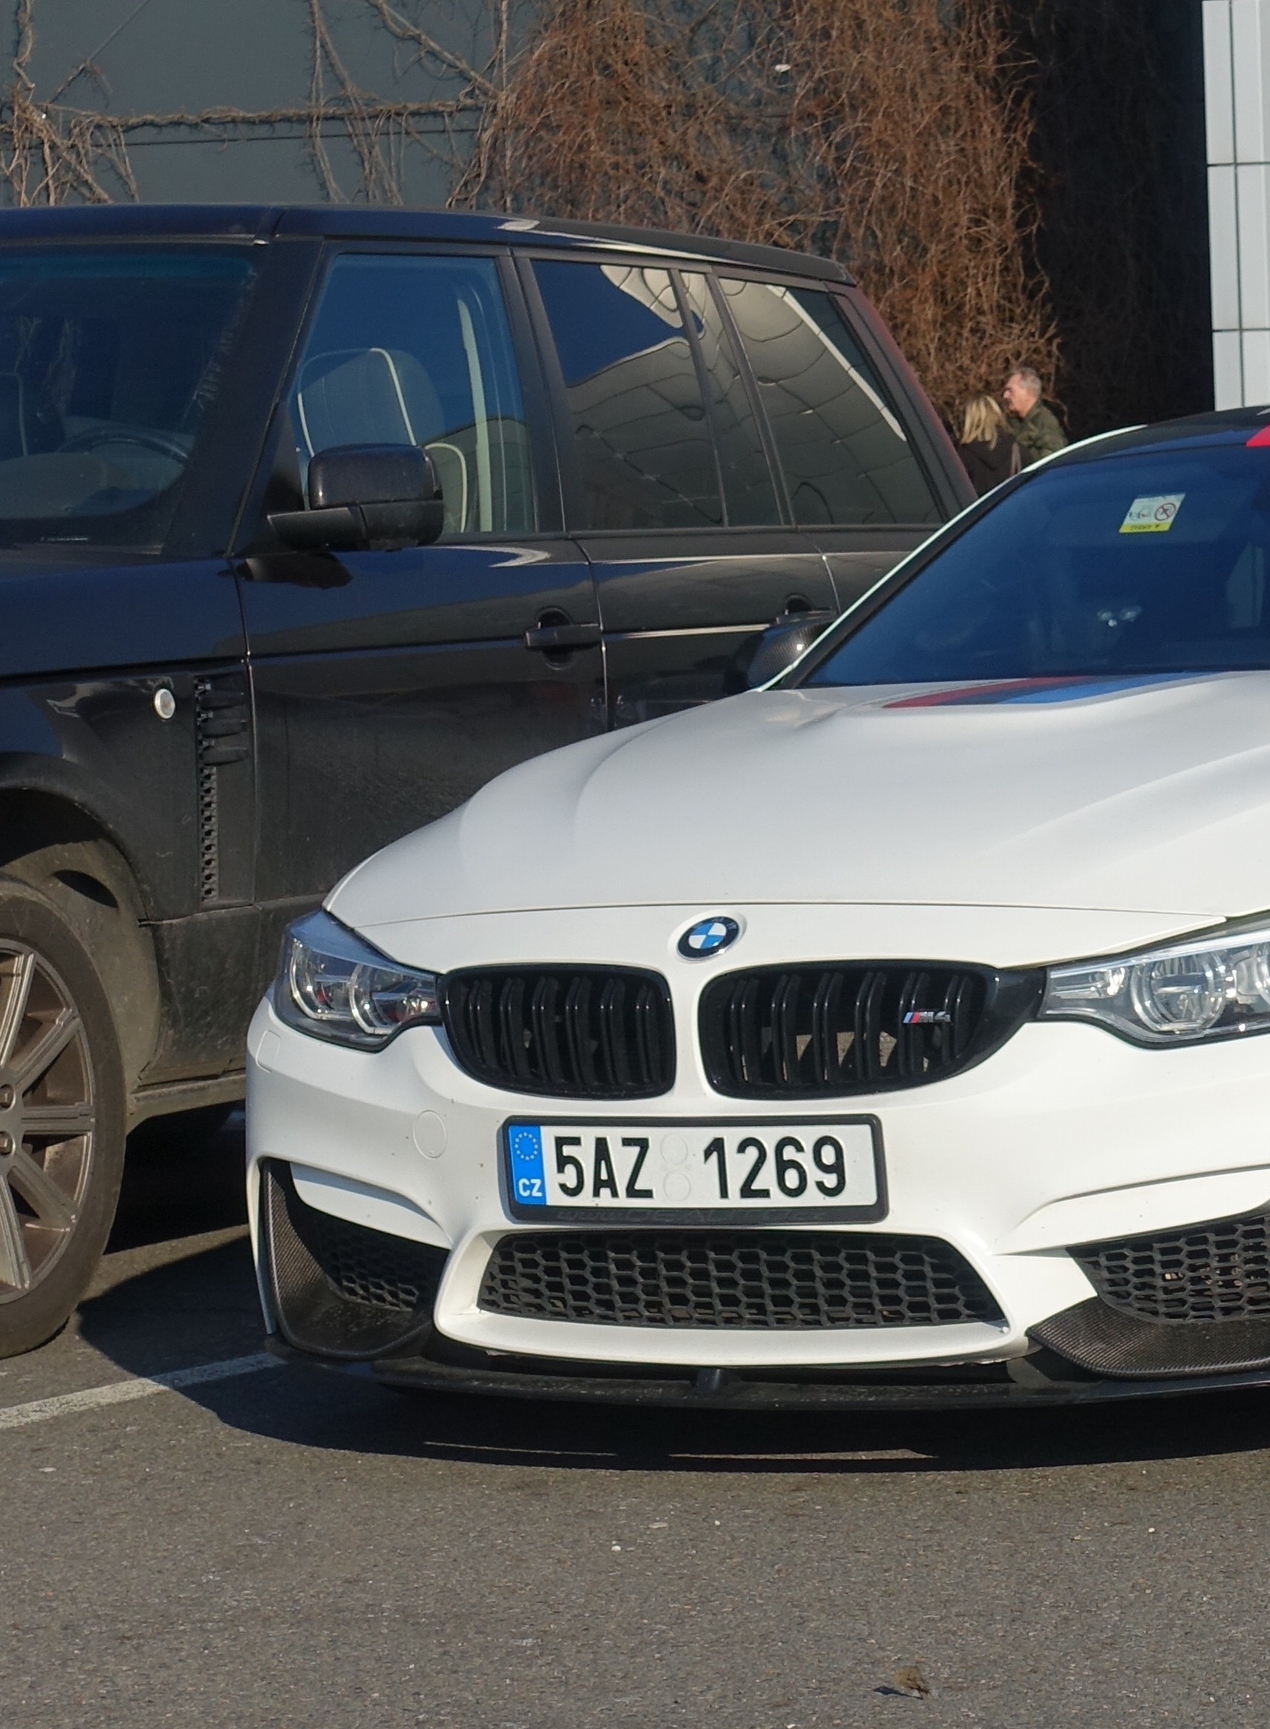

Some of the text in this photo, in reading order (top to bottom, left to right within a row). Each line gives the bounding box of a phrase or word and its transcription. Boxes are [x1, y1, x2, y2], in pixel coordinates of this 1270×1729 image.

[917, 1011, 951, 1023] M4
[554, 1135, 846, 1199] 5AZ 1269
[518, 1178, 542, 1197] CZ
